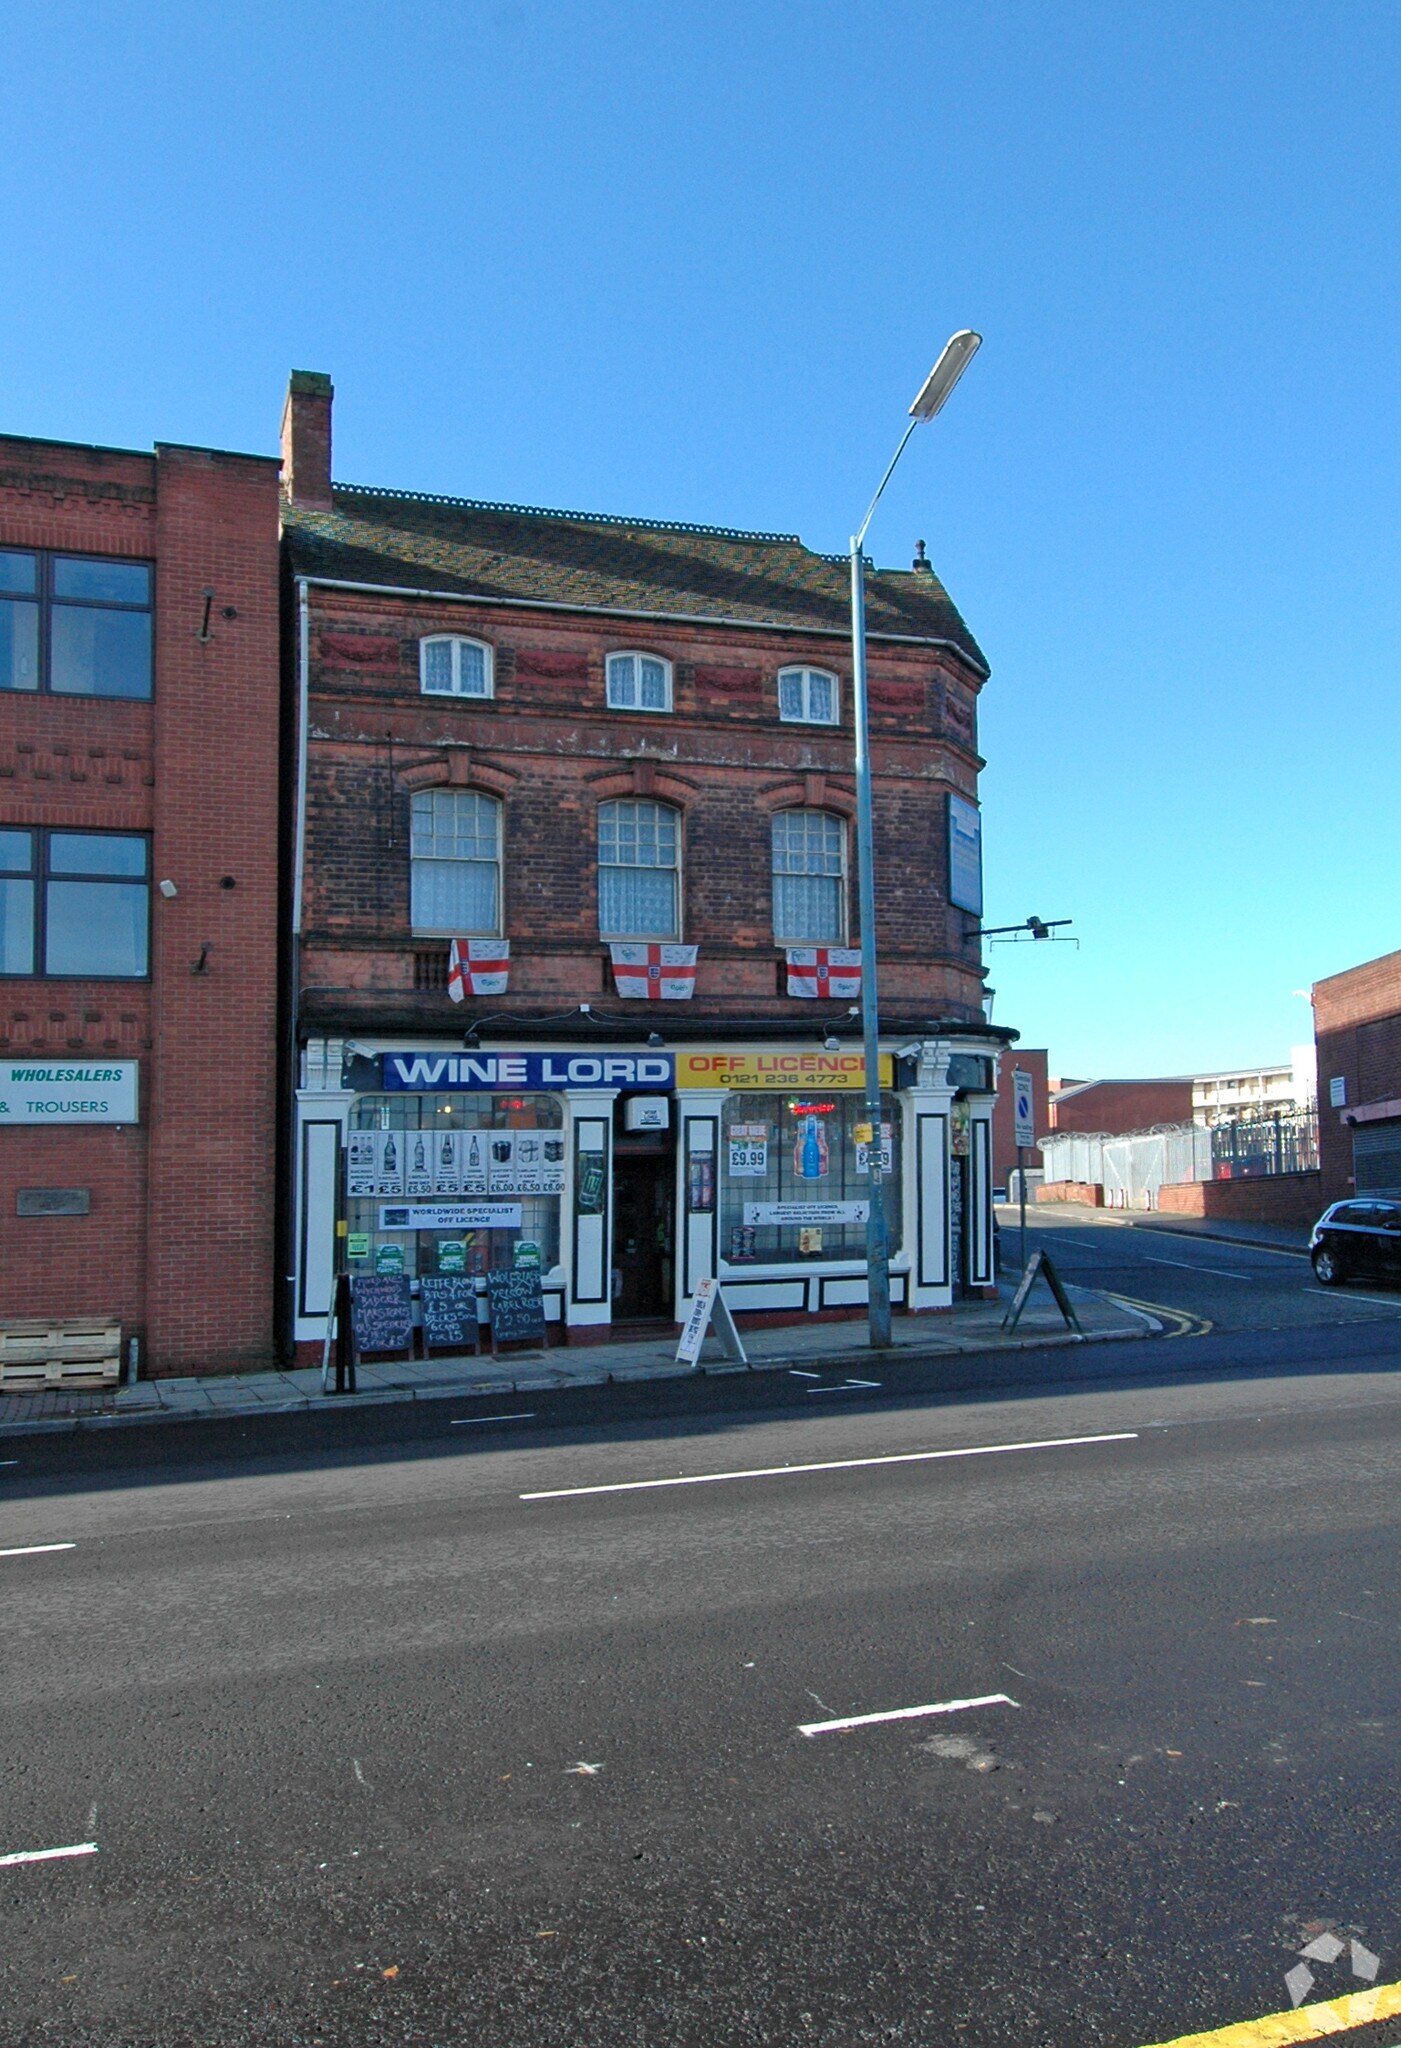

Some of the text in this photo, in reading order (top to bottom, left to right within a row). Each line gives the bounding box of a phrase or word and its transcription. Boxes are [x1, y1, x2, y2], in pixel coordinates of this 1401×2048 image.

[688, 1056, 745, 1072] OFF
[11, 1069, 123, 1082] WHOLESALERS
[394, 1059, 671, 1083] WINE LORD
[720, 1074, 848, 1084] 0121 236 4773
[0, 1101, 109, 1113] & TROUSERS
[731, 1151, 765, 1166] £9.99
[350, 1184, 375, 1194] £1
[378, 1185, 402, 1194] £5
[436, 1184, 459, 1193] £5
[463, 1184, 486, 1193] £5
[412, 1207, 514, 1215] WORLDWIDE SPECIALIST
[438, 1216, 454, 1224] OFF
[359, 1294, 407, 1308] BADGER
